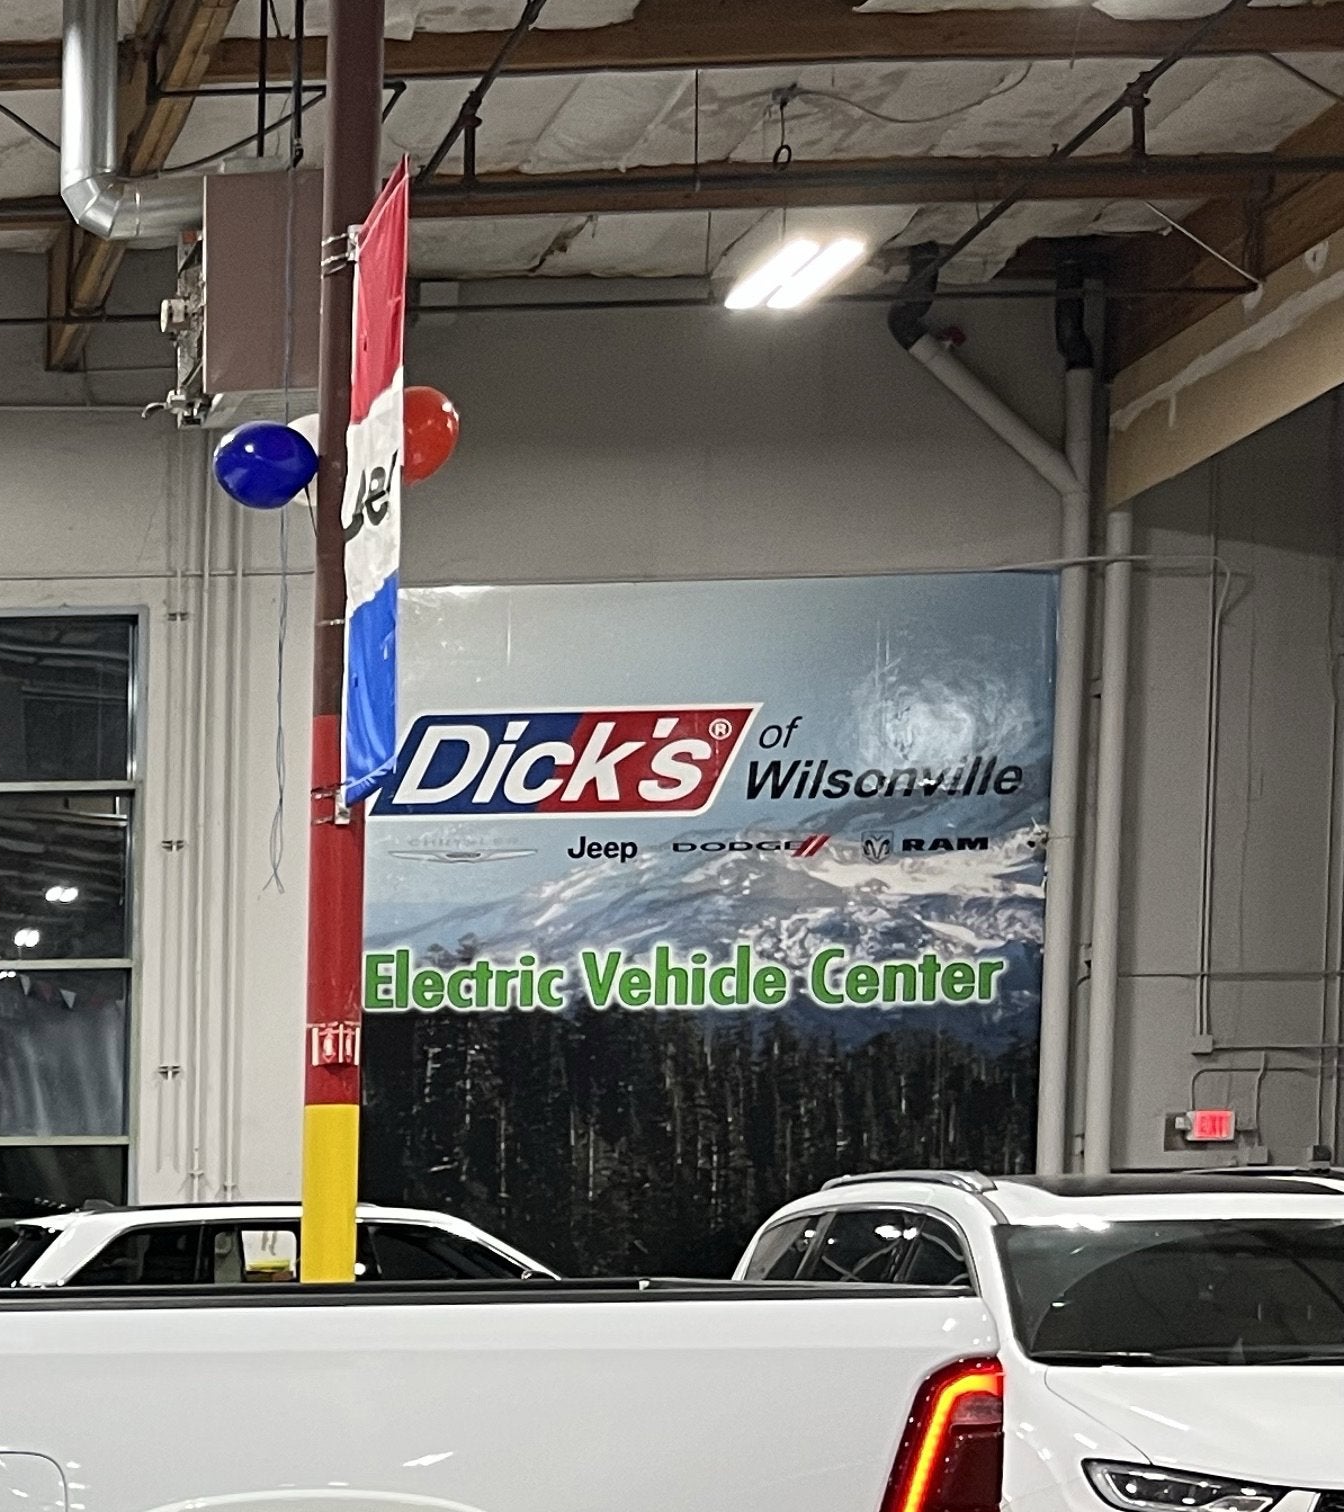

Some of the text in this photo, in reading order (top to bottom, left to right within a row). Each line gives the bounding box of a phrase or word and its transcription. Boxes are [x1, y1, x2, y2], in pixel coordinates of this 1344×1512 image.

[759, 716, 803, 749] of
[746, 755, 1024, 800] Wilsonville
[567, 835, 638, 863] Jeep
[901, 837, 989, 852] RAM
[364, 945, 1005, 1009] Electric Vehicle Center
